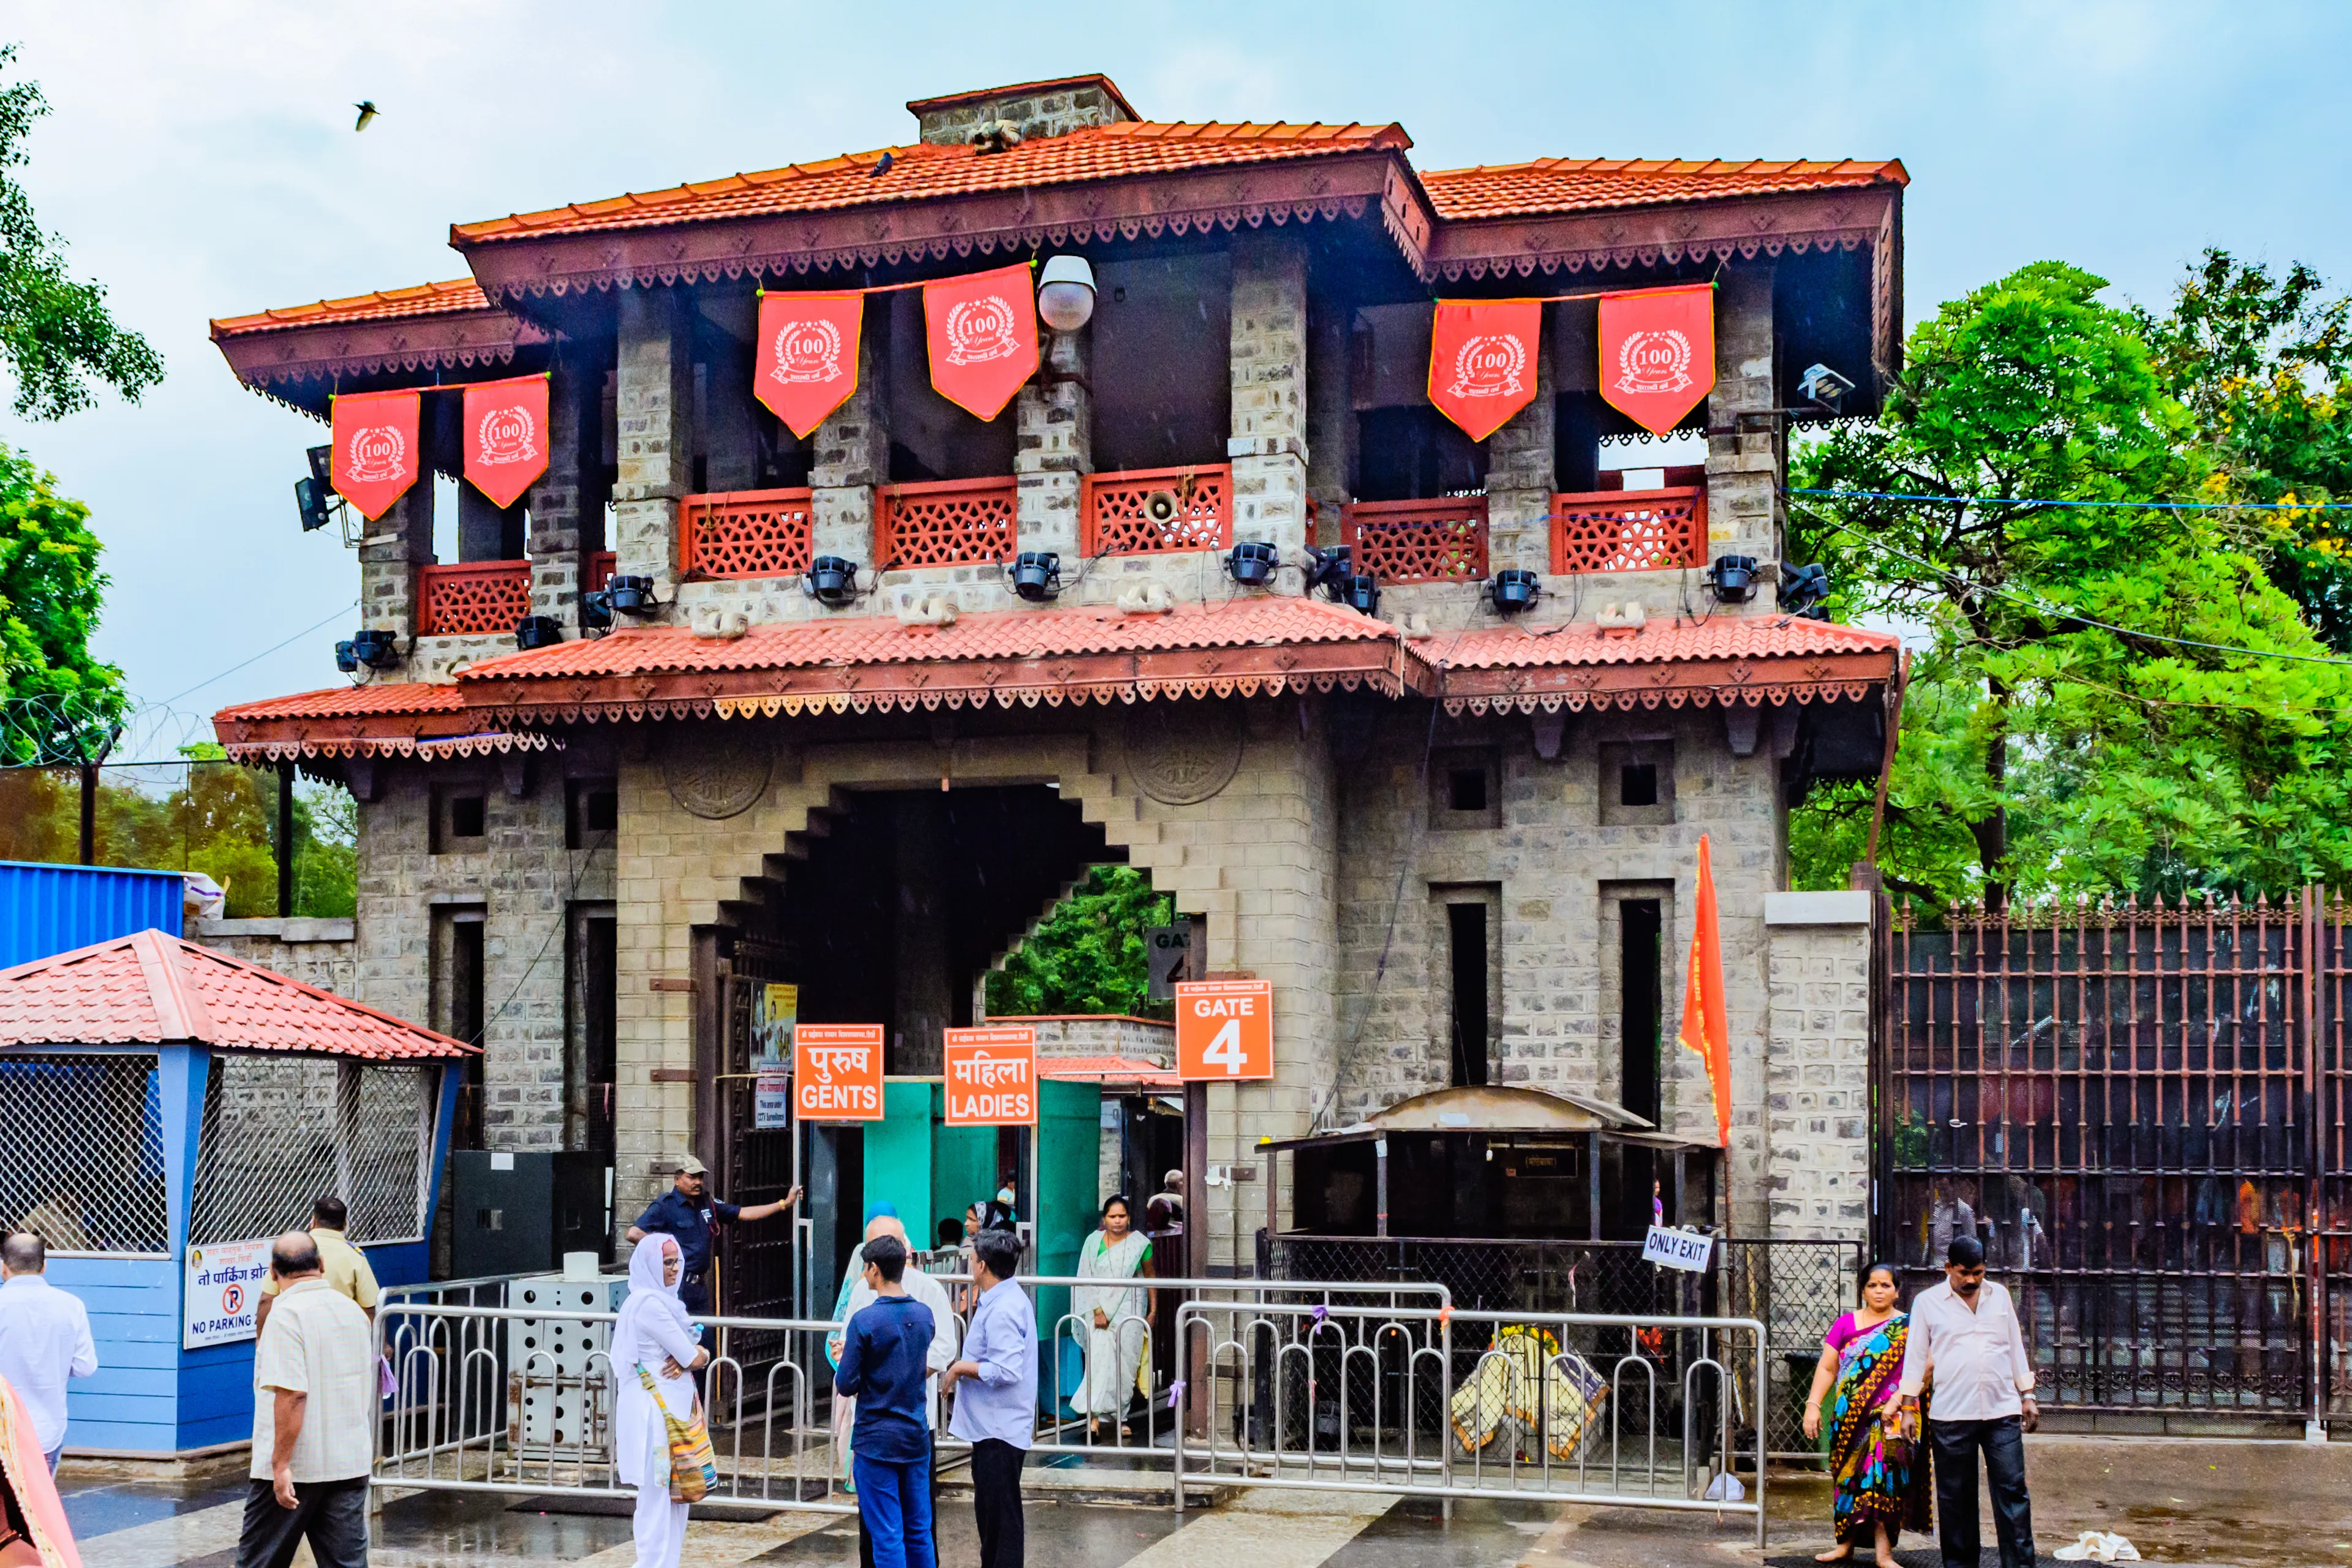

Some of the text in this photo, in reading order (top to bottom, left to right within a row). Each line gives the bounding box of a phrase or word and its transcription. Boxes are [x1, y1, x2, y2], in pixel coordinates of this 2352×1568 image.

[966, 315, 996, 335] 100
[794, 339, 823, 355] 100
[970, 336, 994, 348] Years
[796, 355, 819, 368] Years
[1475, 353, 1507, 369] 100
[1640, 349, 1672, 365] 100
[1476, 370, 1500, 381] Years
[1642, 366, 1667, 377] Years
[494, 423, 519, 440] 100
[366, 442, 390, 458] 100
[1194, 998, 1254, 1017] GATE
[1203, 1019, 1247, 1074] 4
[807, 1047, 871, 1084] पुरुष
[952, 1050, 1028, 1088] महिला
[801, 1085, 876, 1109] GENTS
[951, 1093, 1030, 1118] LADIES
[1649, 1232, 1706, 1261] ONLY EXIT
[192, 1321, 206, 1335] NO
[209, 1314, 251, 1332] PARKING
